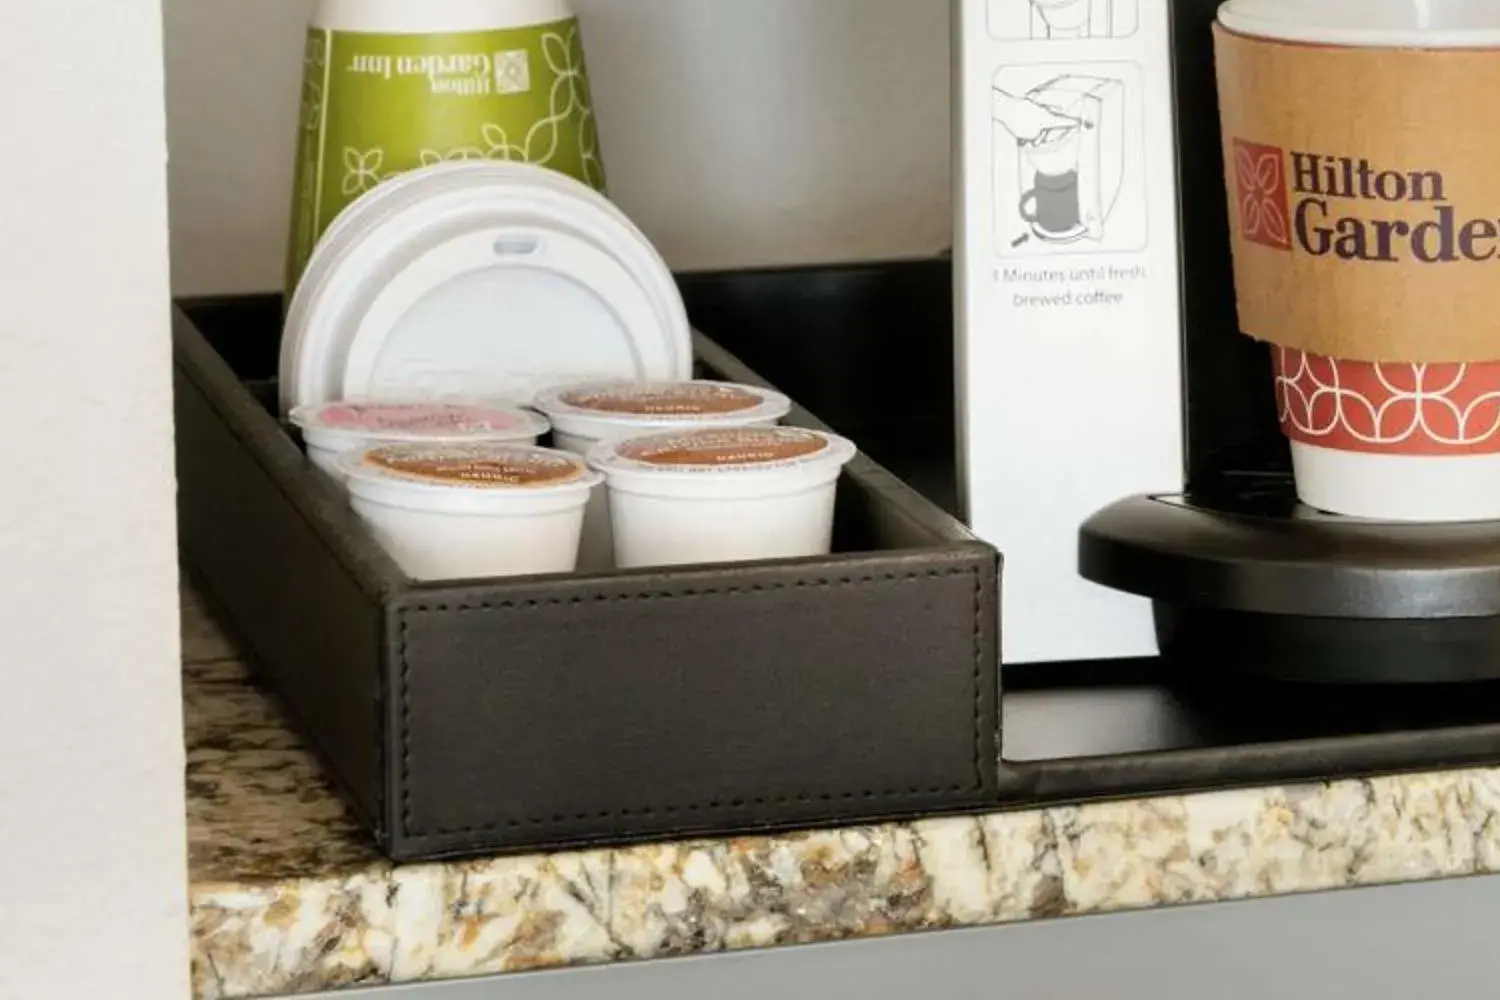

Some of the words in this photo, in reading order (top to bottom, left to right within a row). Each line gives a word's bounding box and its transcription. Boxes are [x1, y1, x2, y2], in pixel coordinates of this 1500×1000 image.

[1290, 151, 1448, 201] Hilton
[1003, 268, 1065, 282] Minutes
[1069, 267, 1105, 282] until
[1108, 265, 1147, 279] fresh
[1012, 292, 1071, 307] brewed
[1075, 290, 1123, 305] coffee
